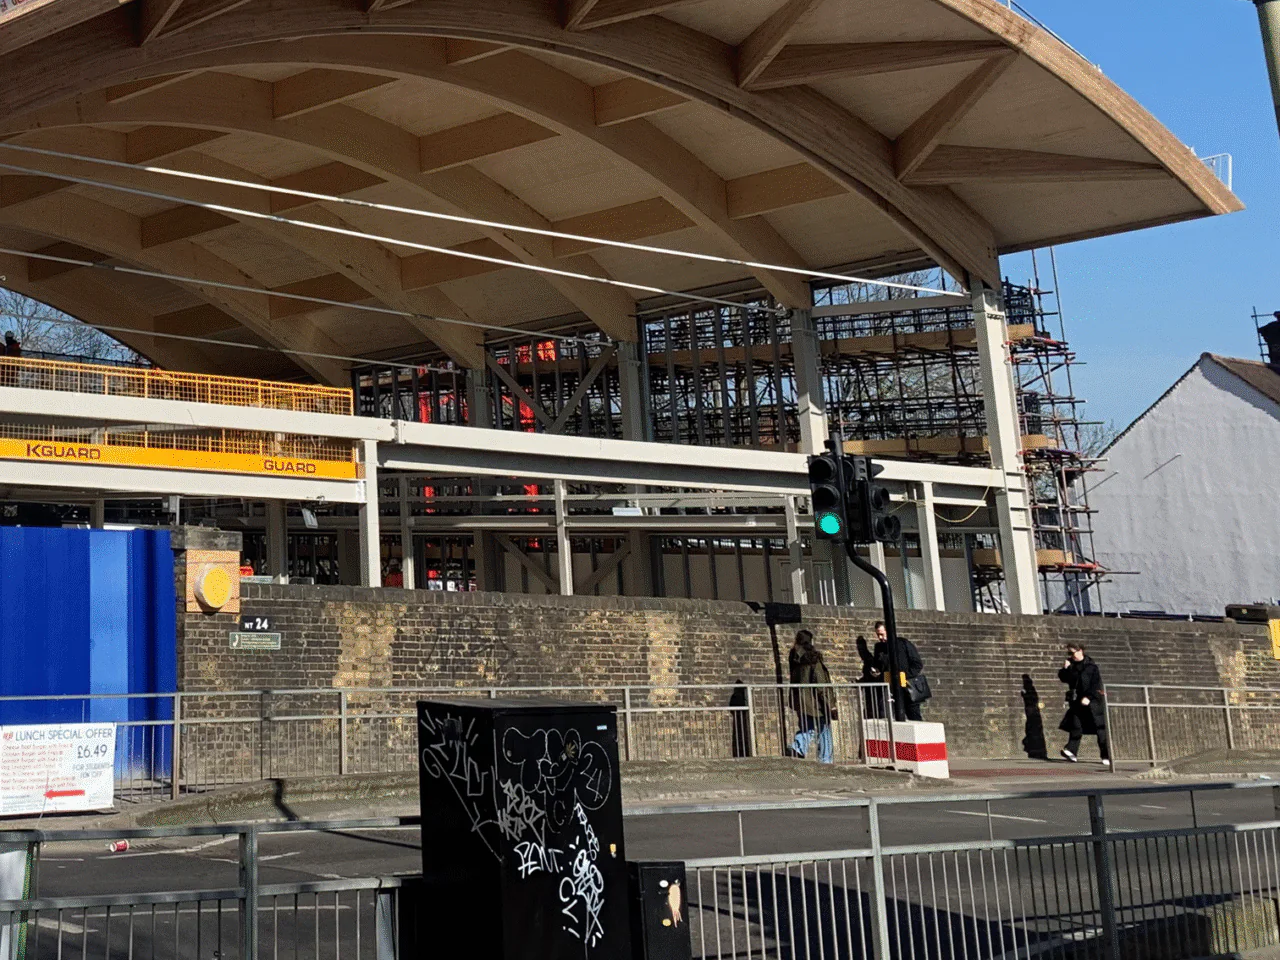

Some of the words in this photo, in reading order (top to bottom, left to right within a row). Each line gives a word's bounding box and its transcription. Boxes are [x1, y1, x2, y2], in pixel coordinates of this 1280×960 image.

[26, 444, 101, 460] KGUARD
[264, 460, 317, 474] GUARD
[255, 617, 269, 630] 24
[15, 730, 45, 741] LUNCH
[47, 728, 83, 740] SPECIAL
[85, 728, 113, 739] OFFER
[77, 744, 108, 759] £6.49
